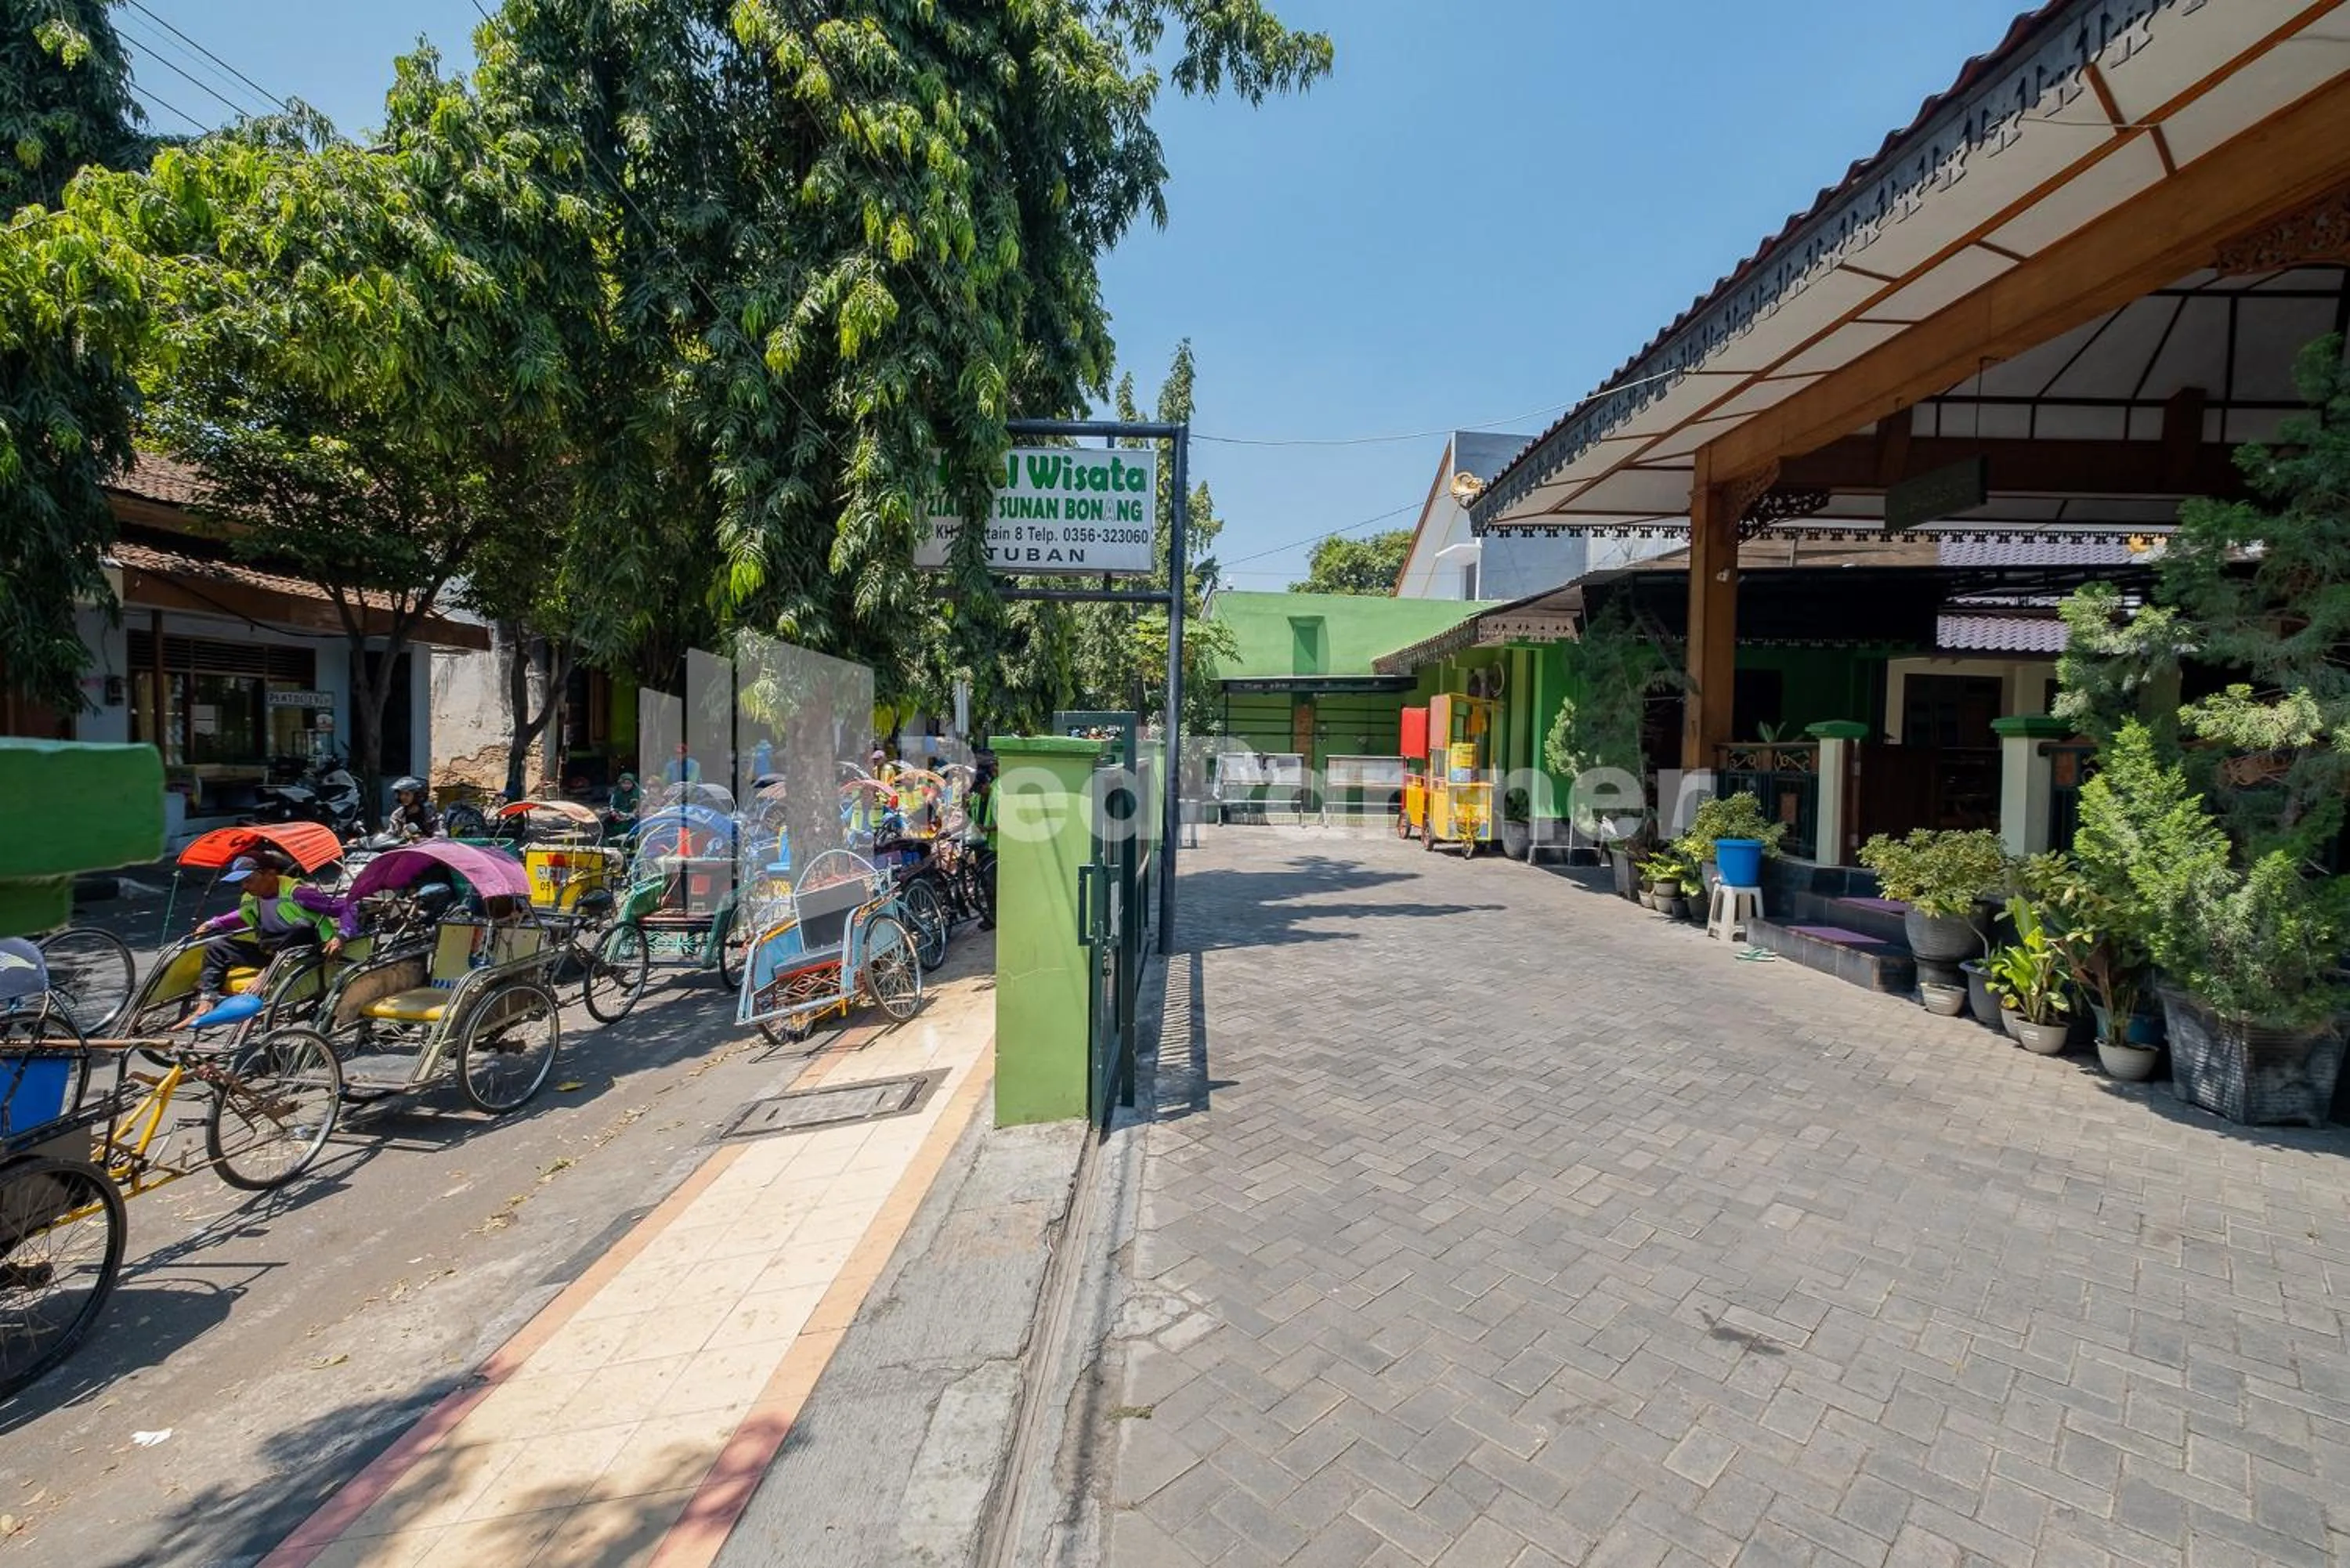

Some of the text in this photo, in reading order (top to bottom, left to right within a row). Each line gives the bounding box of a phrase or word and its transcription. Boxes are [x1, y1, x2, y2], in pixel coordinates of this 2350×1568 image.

[1026, 454, 1147, 492] Wisata
[1000, 497, 1058, 518] SUNAN
[1065, 498, 1143, 521] BONANG
[1014, 526, 1023, 540] 8
[1028, 526, 1058, 545] Telp.
[1063, 527, 1149, 544] 0356-323060
[985, 547, 1085, 562] TUBAN
